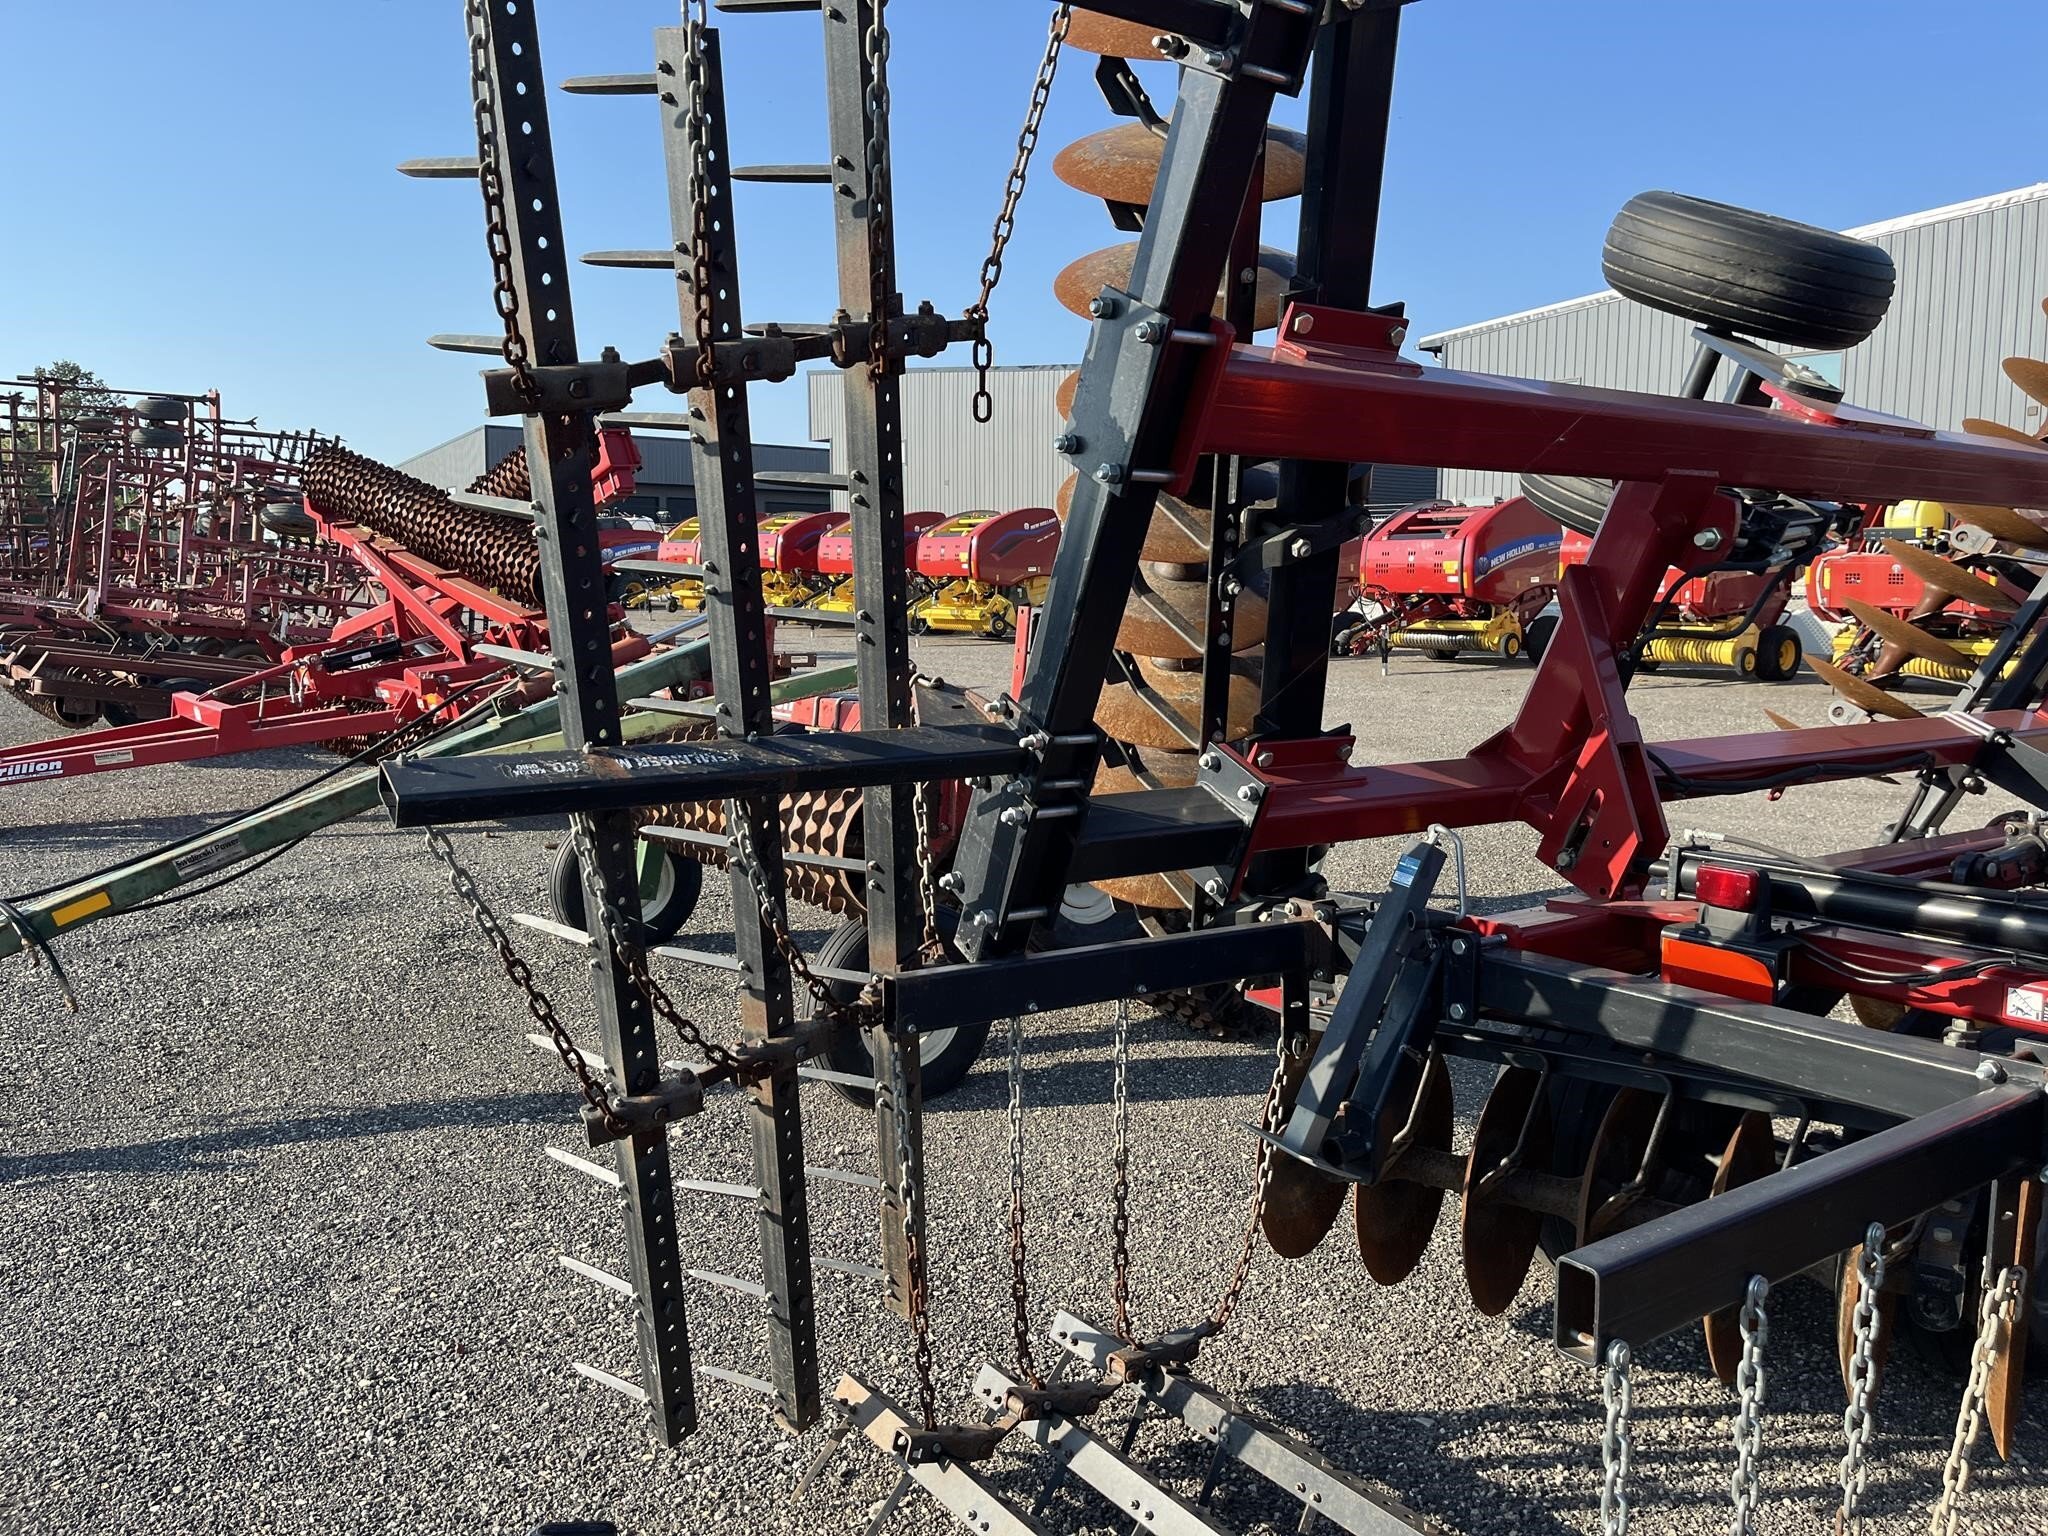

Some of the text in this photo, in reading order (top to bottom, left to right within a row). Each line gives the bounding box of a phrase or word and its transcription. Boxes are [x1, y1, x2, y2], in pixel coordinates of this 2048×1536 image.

[1491, 553, 1506, 567] NEW
[1506, 543, 1535, 559] HOLLAND
[215, 838, 239, 852] Power
